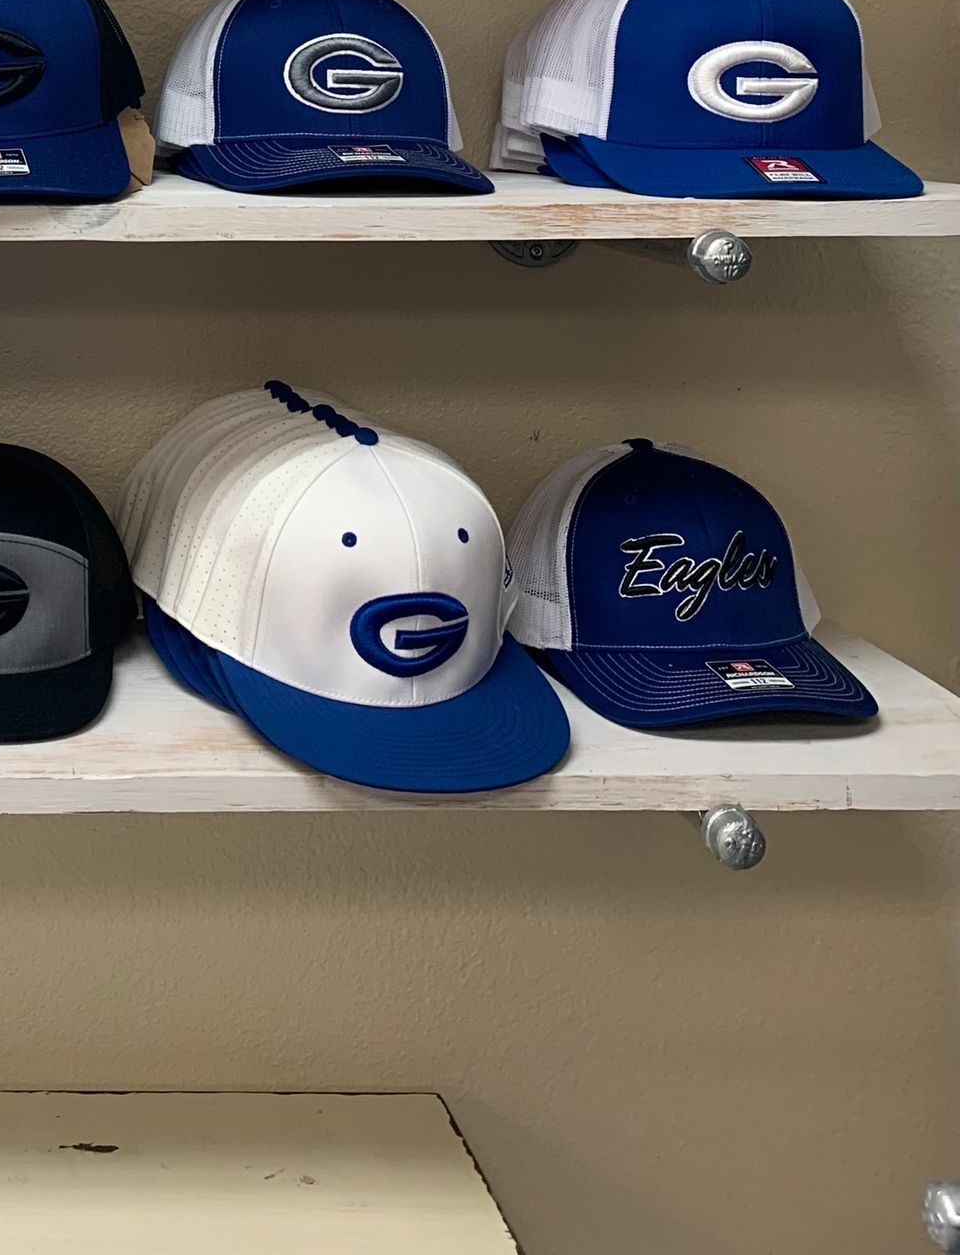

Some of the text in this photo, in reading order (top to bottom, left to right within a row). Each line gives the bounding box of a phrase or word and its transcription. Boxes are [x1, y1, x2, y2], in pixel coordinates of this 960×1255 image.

[284, 32, 404, 115] G
[687, 40, 819, 123] G
[619, 530, 778, 622] Eagles
[349, 591, 469, 679] G
